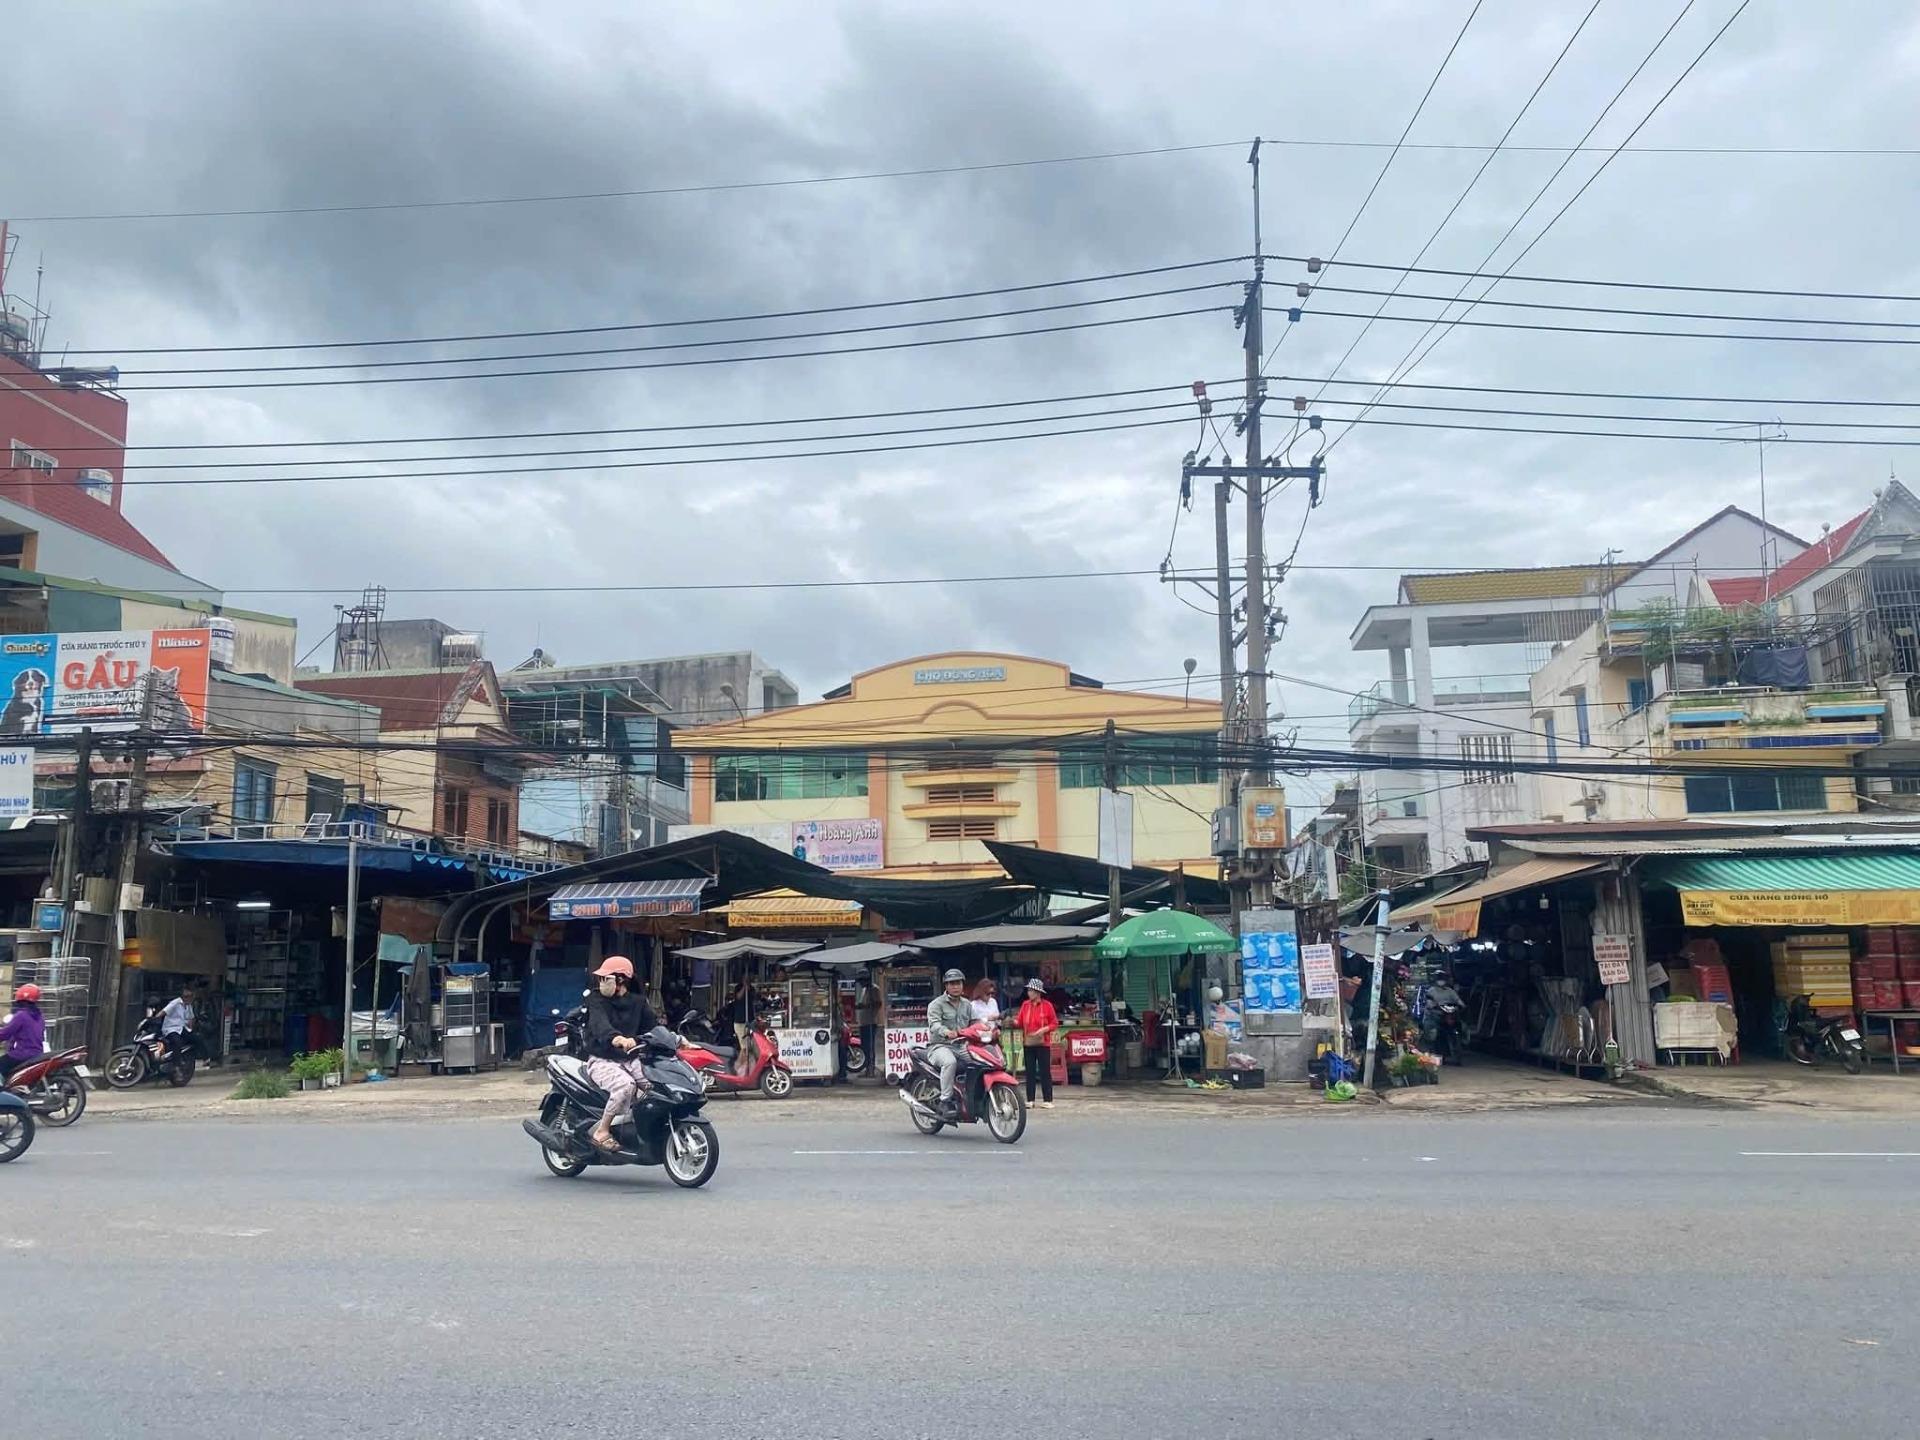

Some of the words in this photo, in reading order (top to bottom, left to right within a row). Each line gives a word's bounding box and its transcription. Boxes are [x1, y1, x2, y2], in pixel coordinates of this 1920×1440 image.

[63, 651, 138, 690] GẤU
[21, 754, 27, 764] Y
[819, 824, 853, 844] Hoàng
[855, 822, 879, 839] Anh
